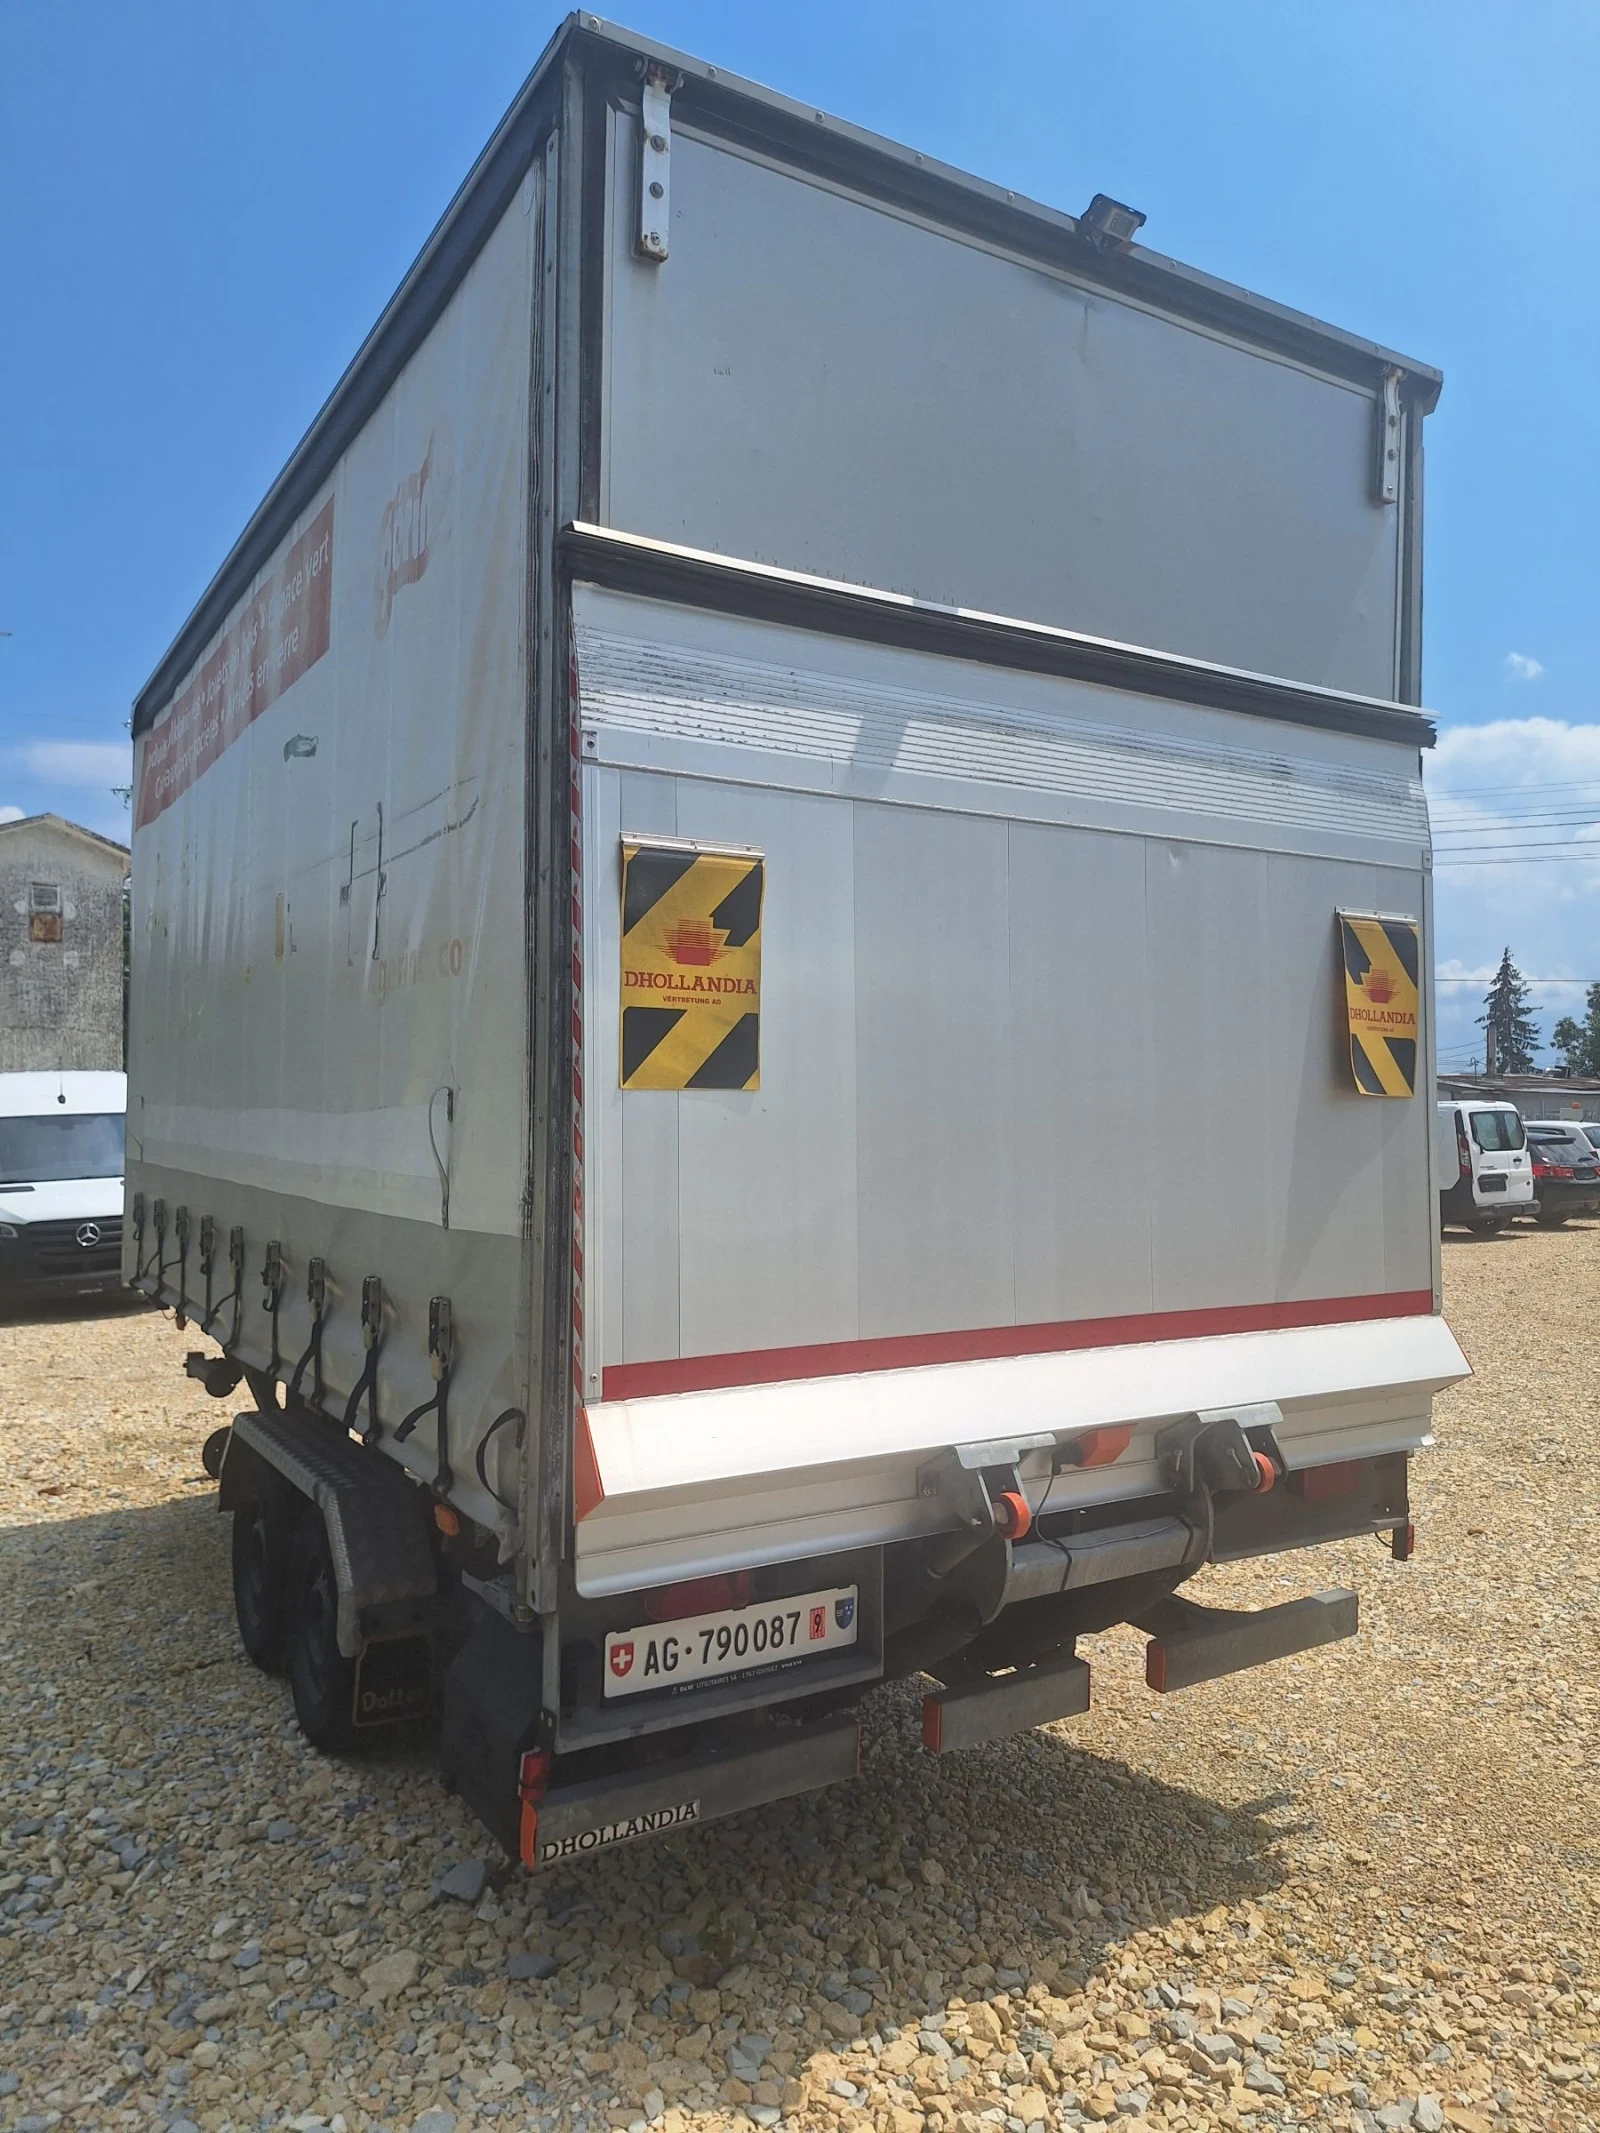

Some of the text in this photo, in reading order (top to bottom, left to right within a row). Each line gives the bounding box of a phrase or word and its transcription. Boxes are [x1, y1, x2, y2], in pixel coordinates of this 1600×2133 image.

[306, 529, 330, 584] vert
[624, 971, 757, 994] DHOLLANDIA
[662, 996, 709, 1004] VERTRETUNG
[1350, 1007, 1416, 1025] DHOLLANDIA
[814, 1613, 822, 1634] 9
[541, 1801, 698, 1862] DHOLLANDIA
